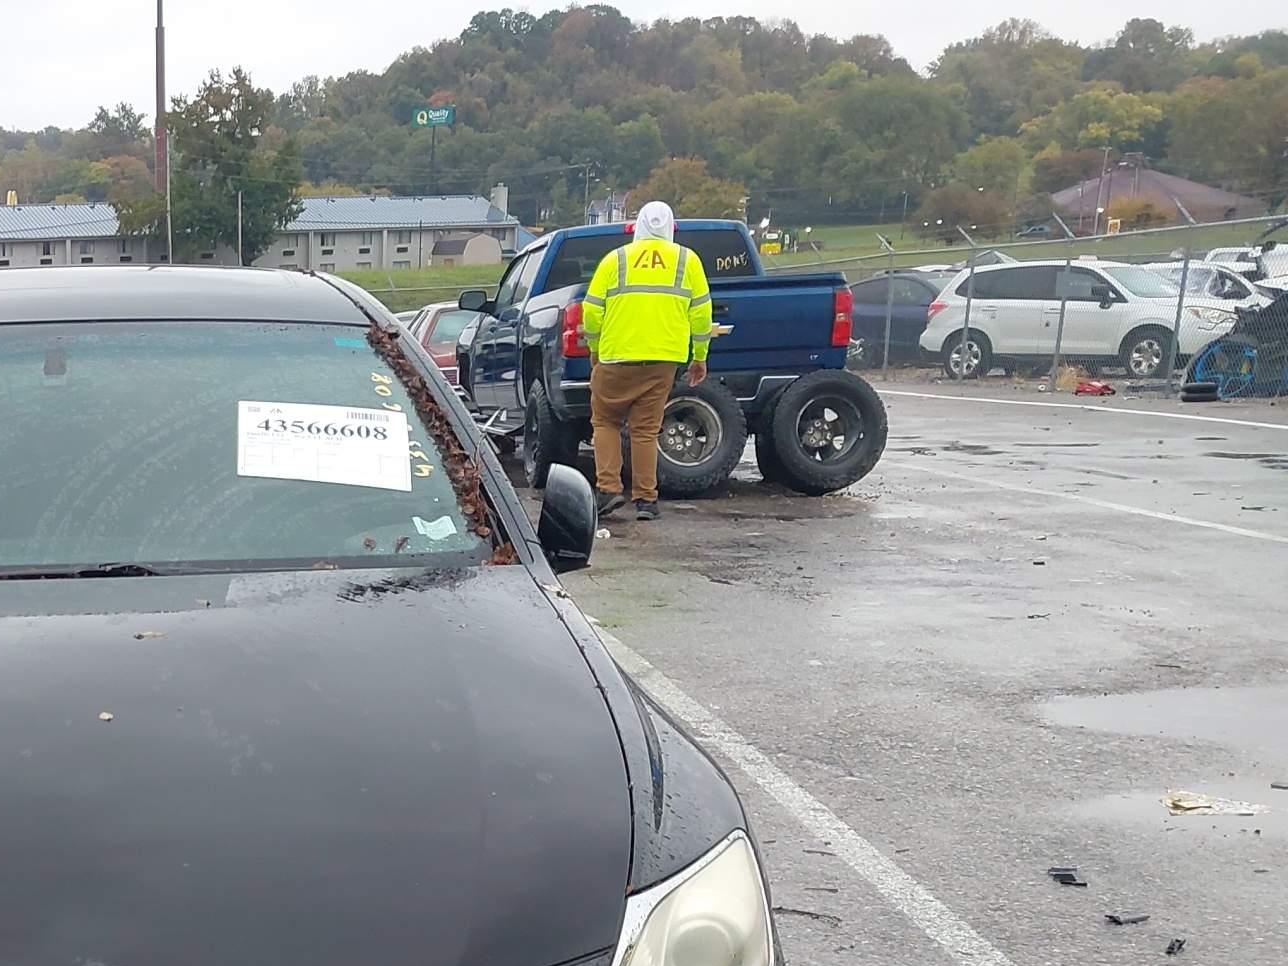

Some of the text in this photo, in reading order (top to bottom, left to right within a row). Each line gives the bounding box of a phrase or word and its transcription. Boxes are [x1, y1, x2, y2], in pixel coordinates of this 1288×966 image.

[428, 109, 449, 120] Quality
[716, 251, 748, 271] DONE
[256, 418, 388, 441] 43566608
